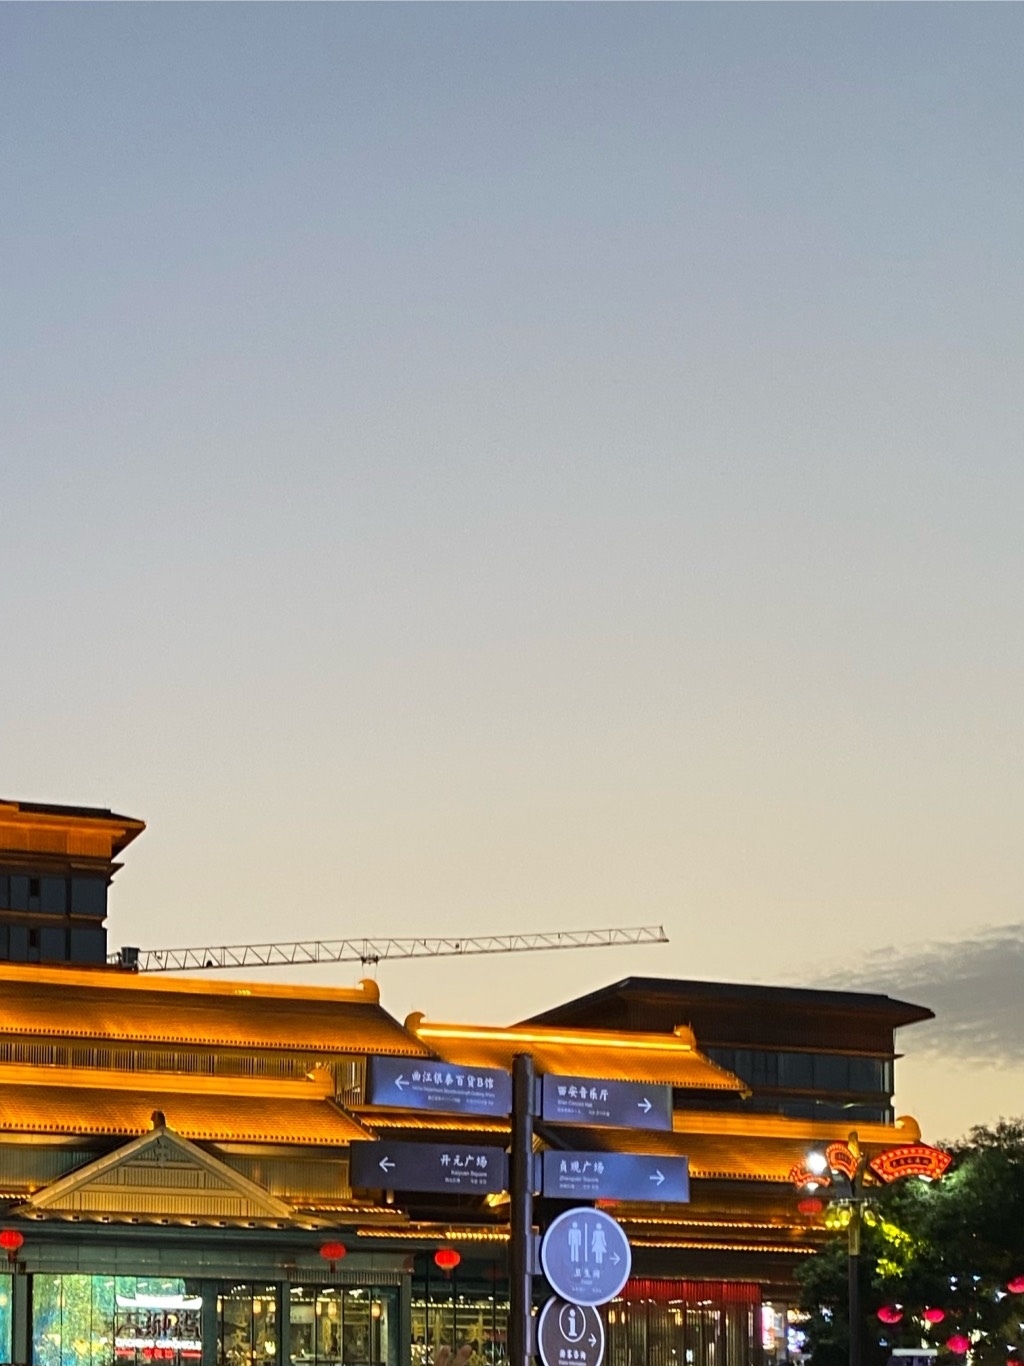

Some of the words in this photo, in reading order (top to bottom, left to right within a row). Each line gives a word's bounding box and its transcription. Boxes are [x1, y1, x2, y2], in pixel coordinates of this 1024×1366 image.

[557, 1084, 609, 1102] 西安音乐厅
[440, 1154, 488, 1169] 开元广场
[560, 1160, 605, 1175] 贞观广场
